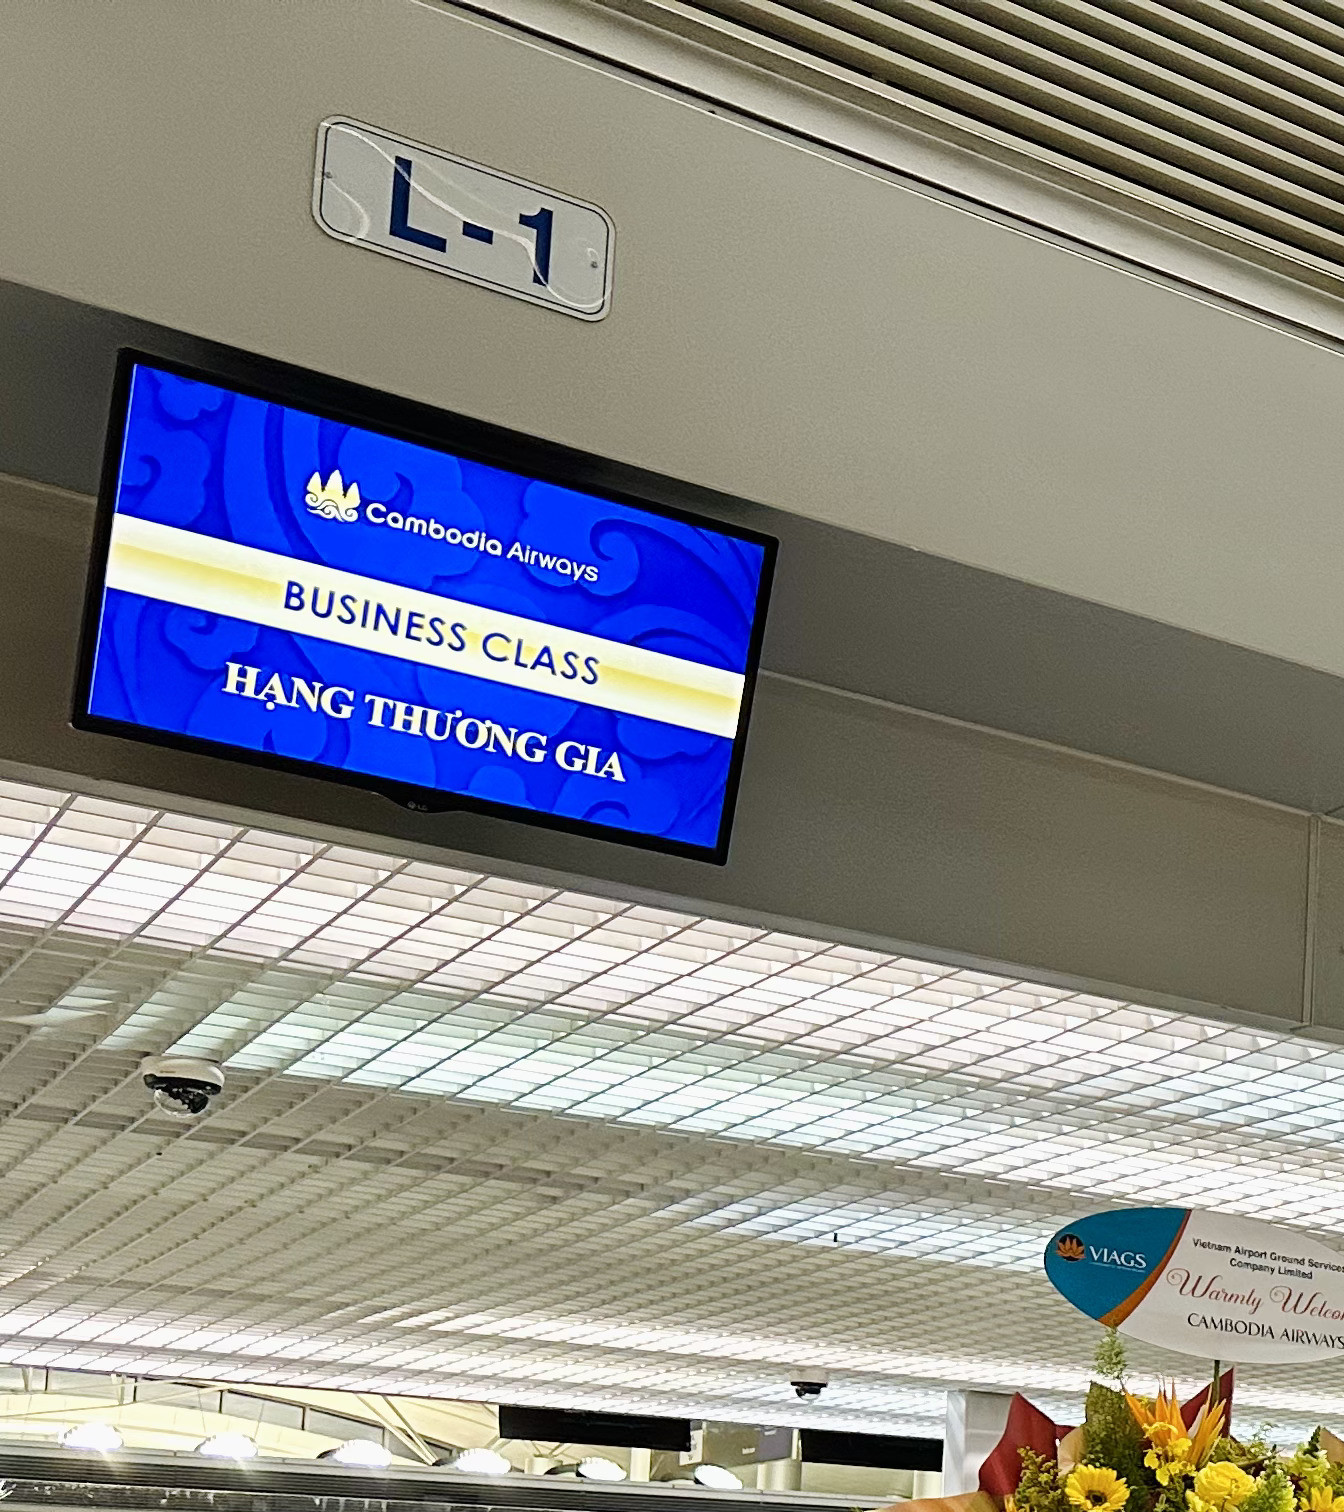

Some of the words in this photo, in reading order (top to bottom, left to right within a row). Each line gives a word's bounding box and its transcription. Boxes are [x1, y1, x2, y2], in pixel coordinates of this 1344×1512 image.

[389, 155, 554, 287] L-1
[366, 502, 502, 557] Cambodia
[507, 541, 600, 584] Airways
[284, 580, 467, 652] BUSINESS
[482, 631, 600, 685] CLASS
[221, 662, 355, 719] HẠNG
[364, 694, 547, 763] THƯƠNG
[555, 740, 626, 782] GIA
[1089, 1245, 1147, 1269] VIAGS
[1192, 1238, 1232, 1254] Vietnam
[1234, 1246, 1268, 1261] Airport
[1270, 1252, 1305, 1267] Ground
[1229, 1258, 1275, 1276] Company
[1278, 1267, 1313, 1280] Limited
[1166, 1268, 1264, 1315] Warmly
[1187, 1312, 1275, 1340] CAMBODIA
